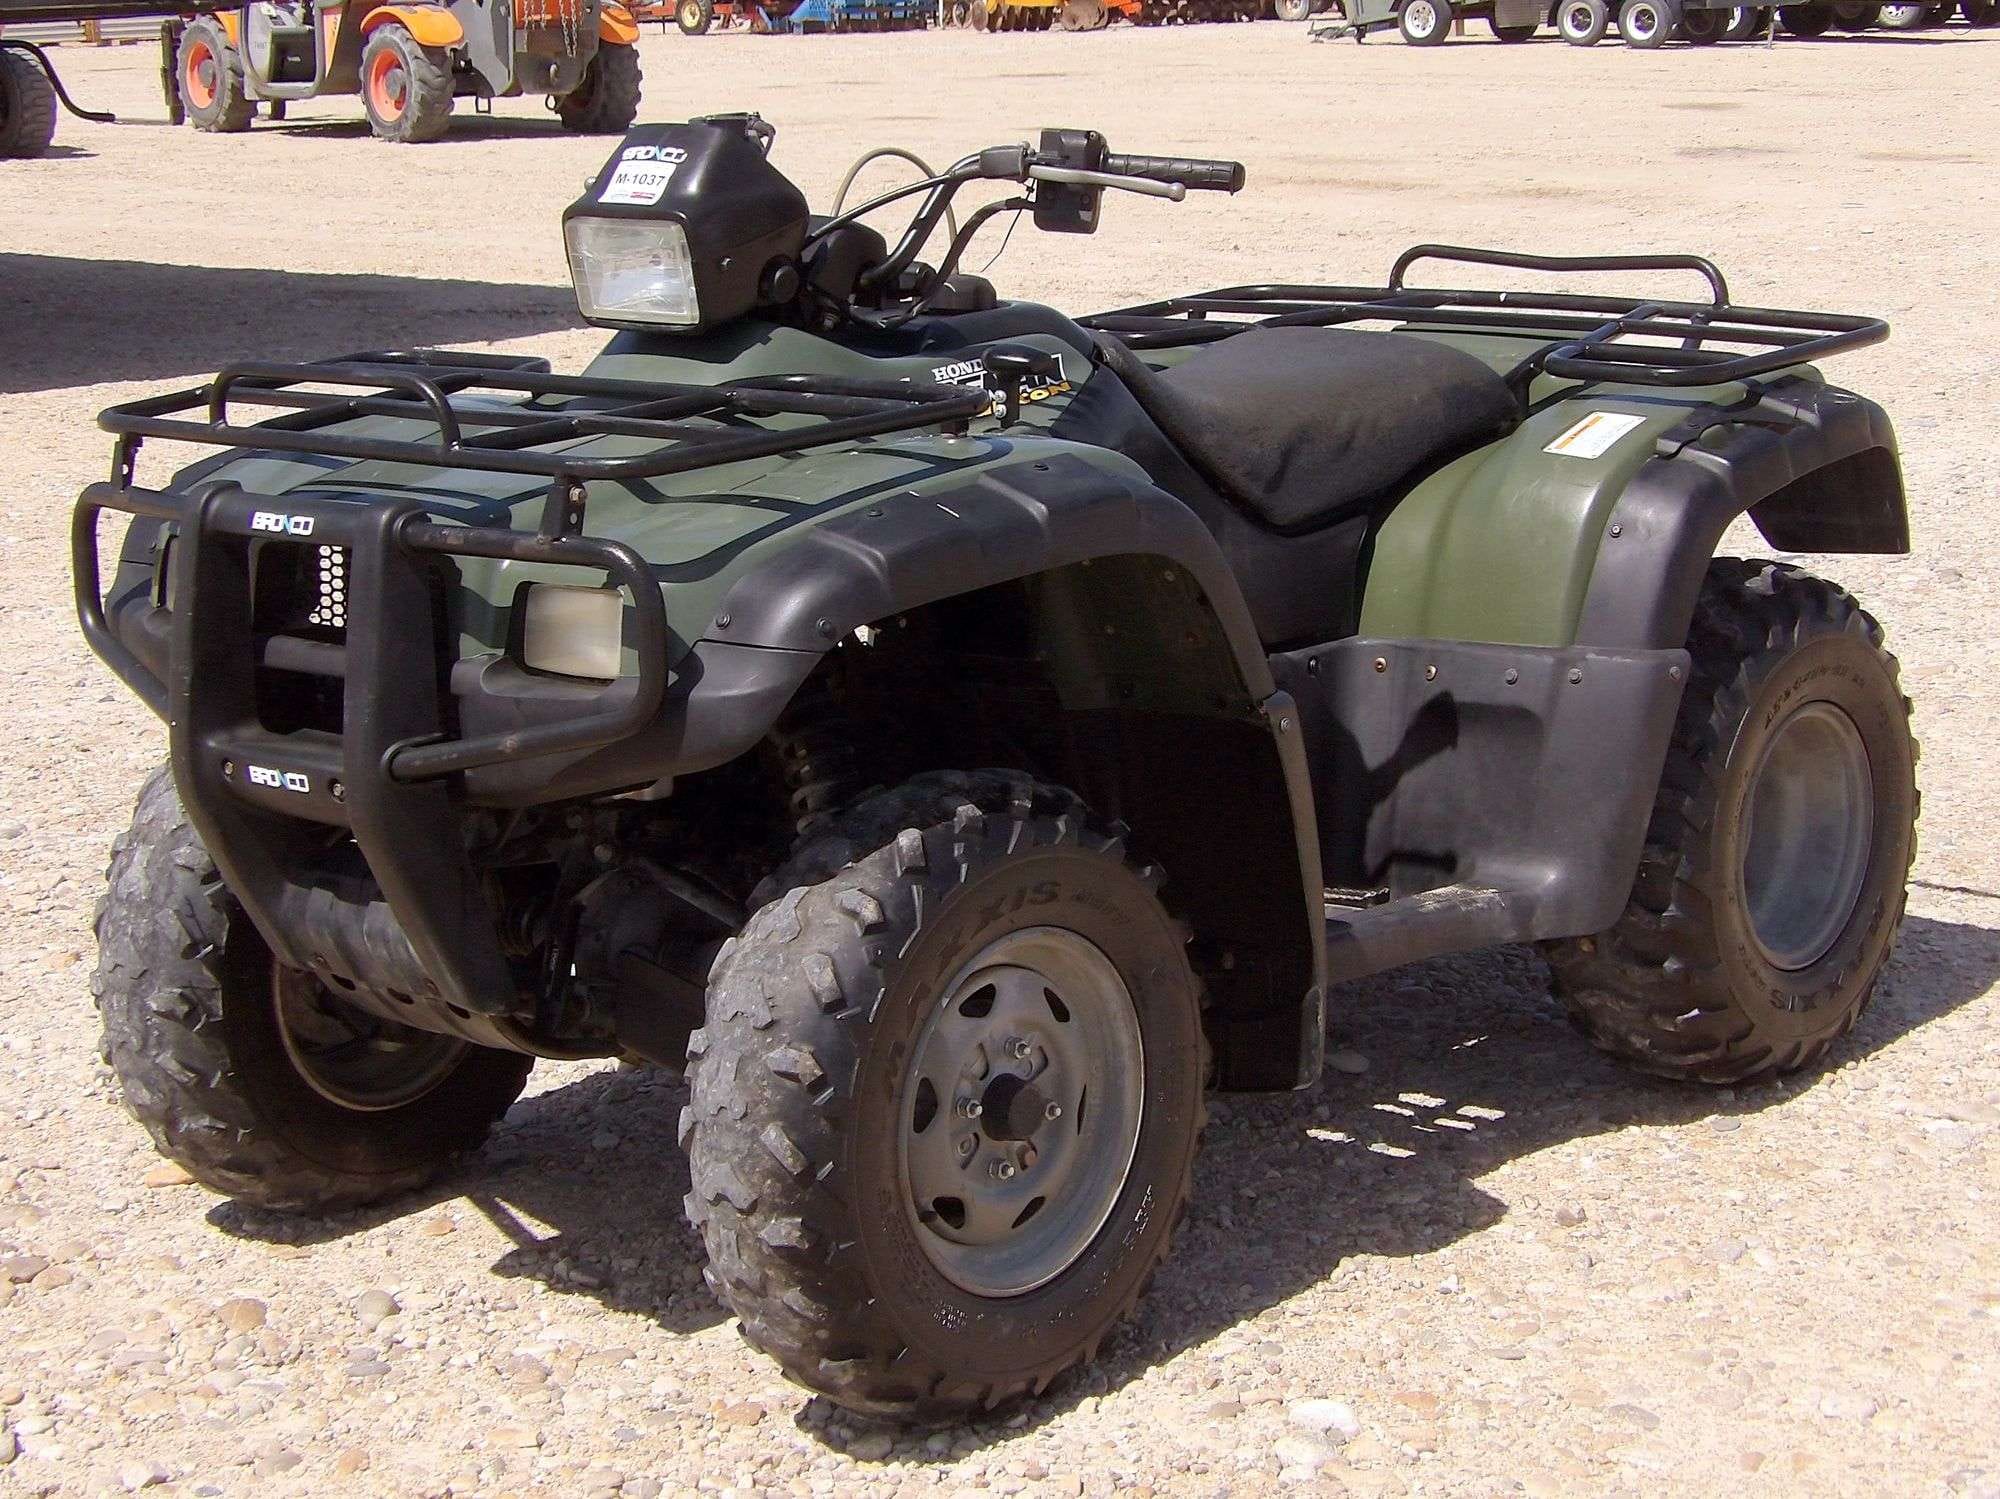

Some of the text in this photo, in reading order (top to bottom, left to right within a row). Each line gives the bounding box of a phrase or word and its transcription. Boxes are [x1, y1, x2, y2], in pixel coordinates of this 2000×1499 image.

[622, 145, 688, 164] BRONCO
[616, 173, 666, 186] M-1037
[931, 358, 984, 382] HOND
[251, 511, 314, 535] BRONCO
[248, 765, 310, 793] BRONCO
